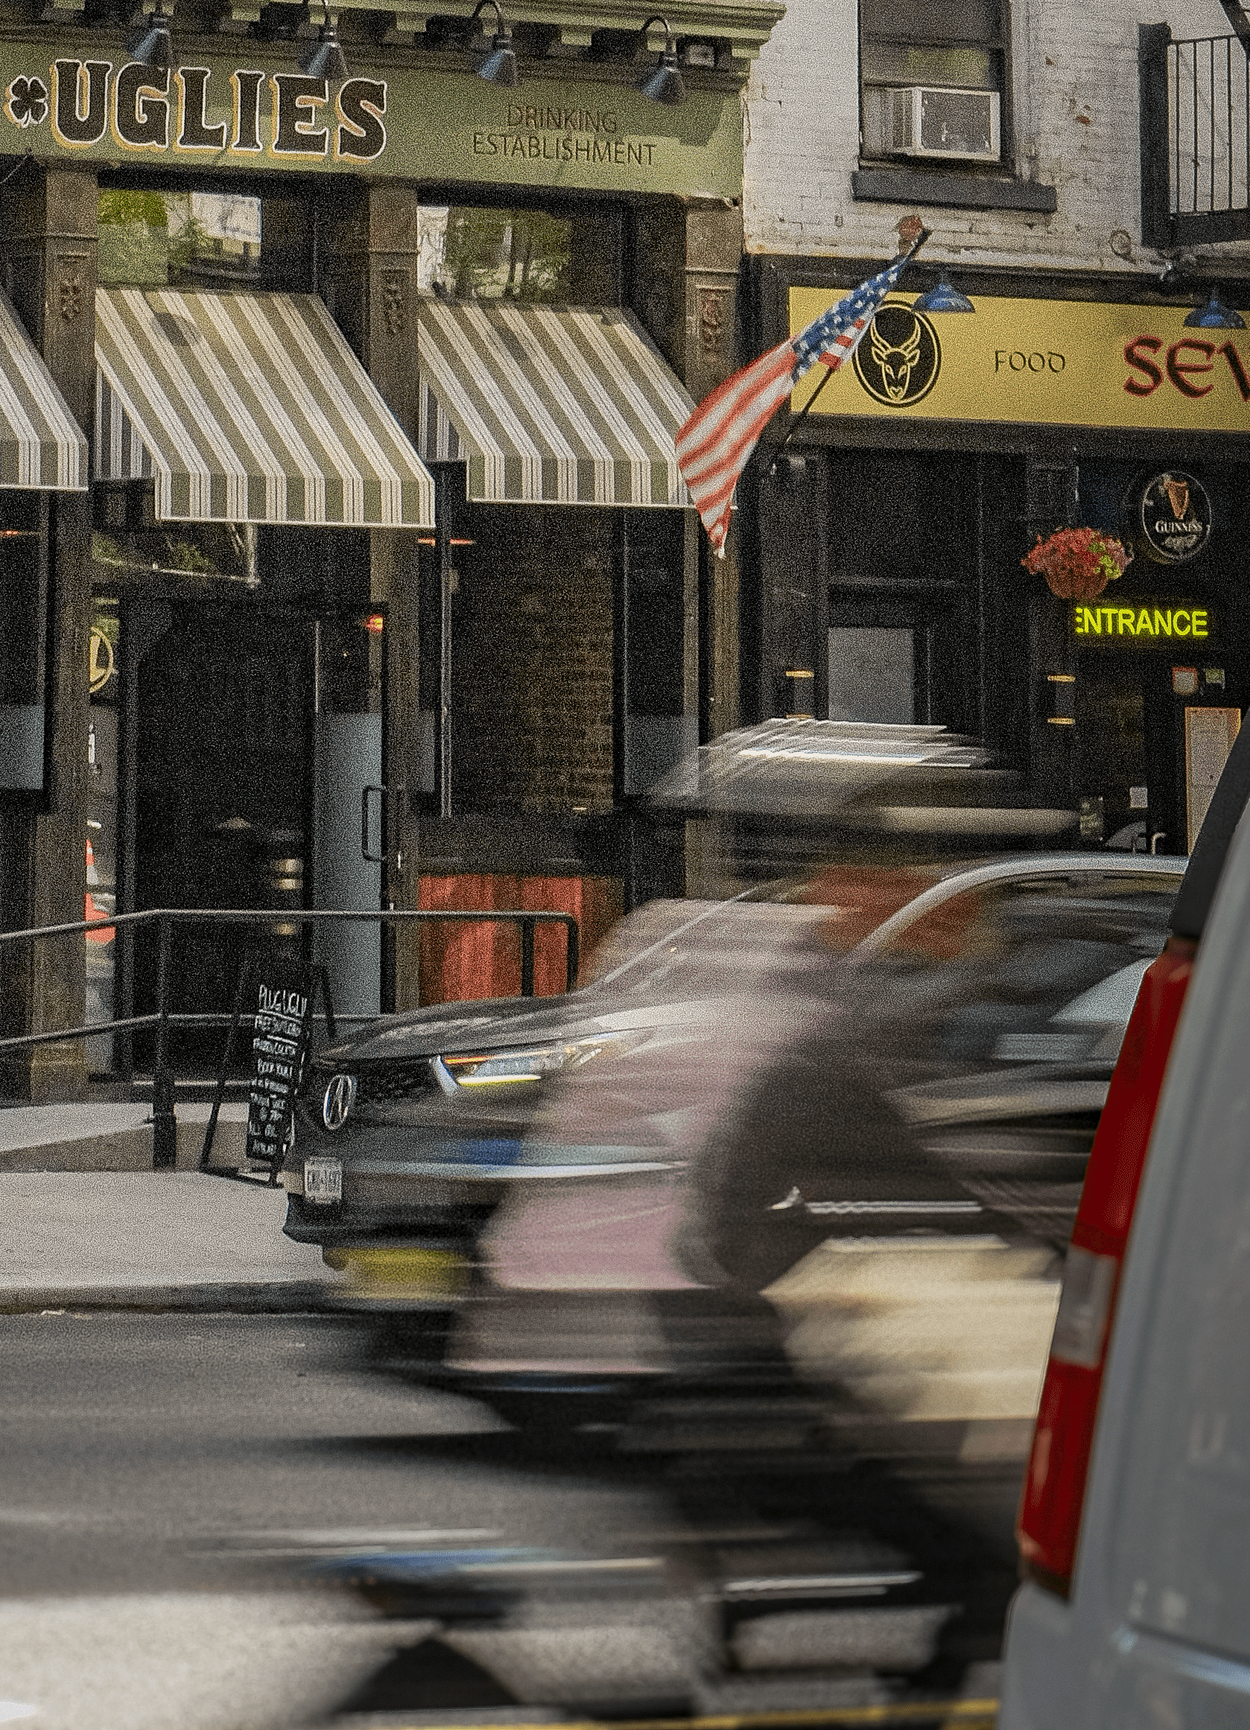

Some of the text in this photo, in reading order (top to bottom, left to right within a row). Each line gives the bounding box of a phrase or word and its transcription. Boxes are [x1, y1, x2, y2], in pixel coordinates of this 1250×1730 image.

[51, 60, 388, 161] UGLIES
[506, 104, 618, 133] DRINKING
[473, 132, 657, 165] ESTABLISHMENT
[994, 349, 1066, 374] FOOD
